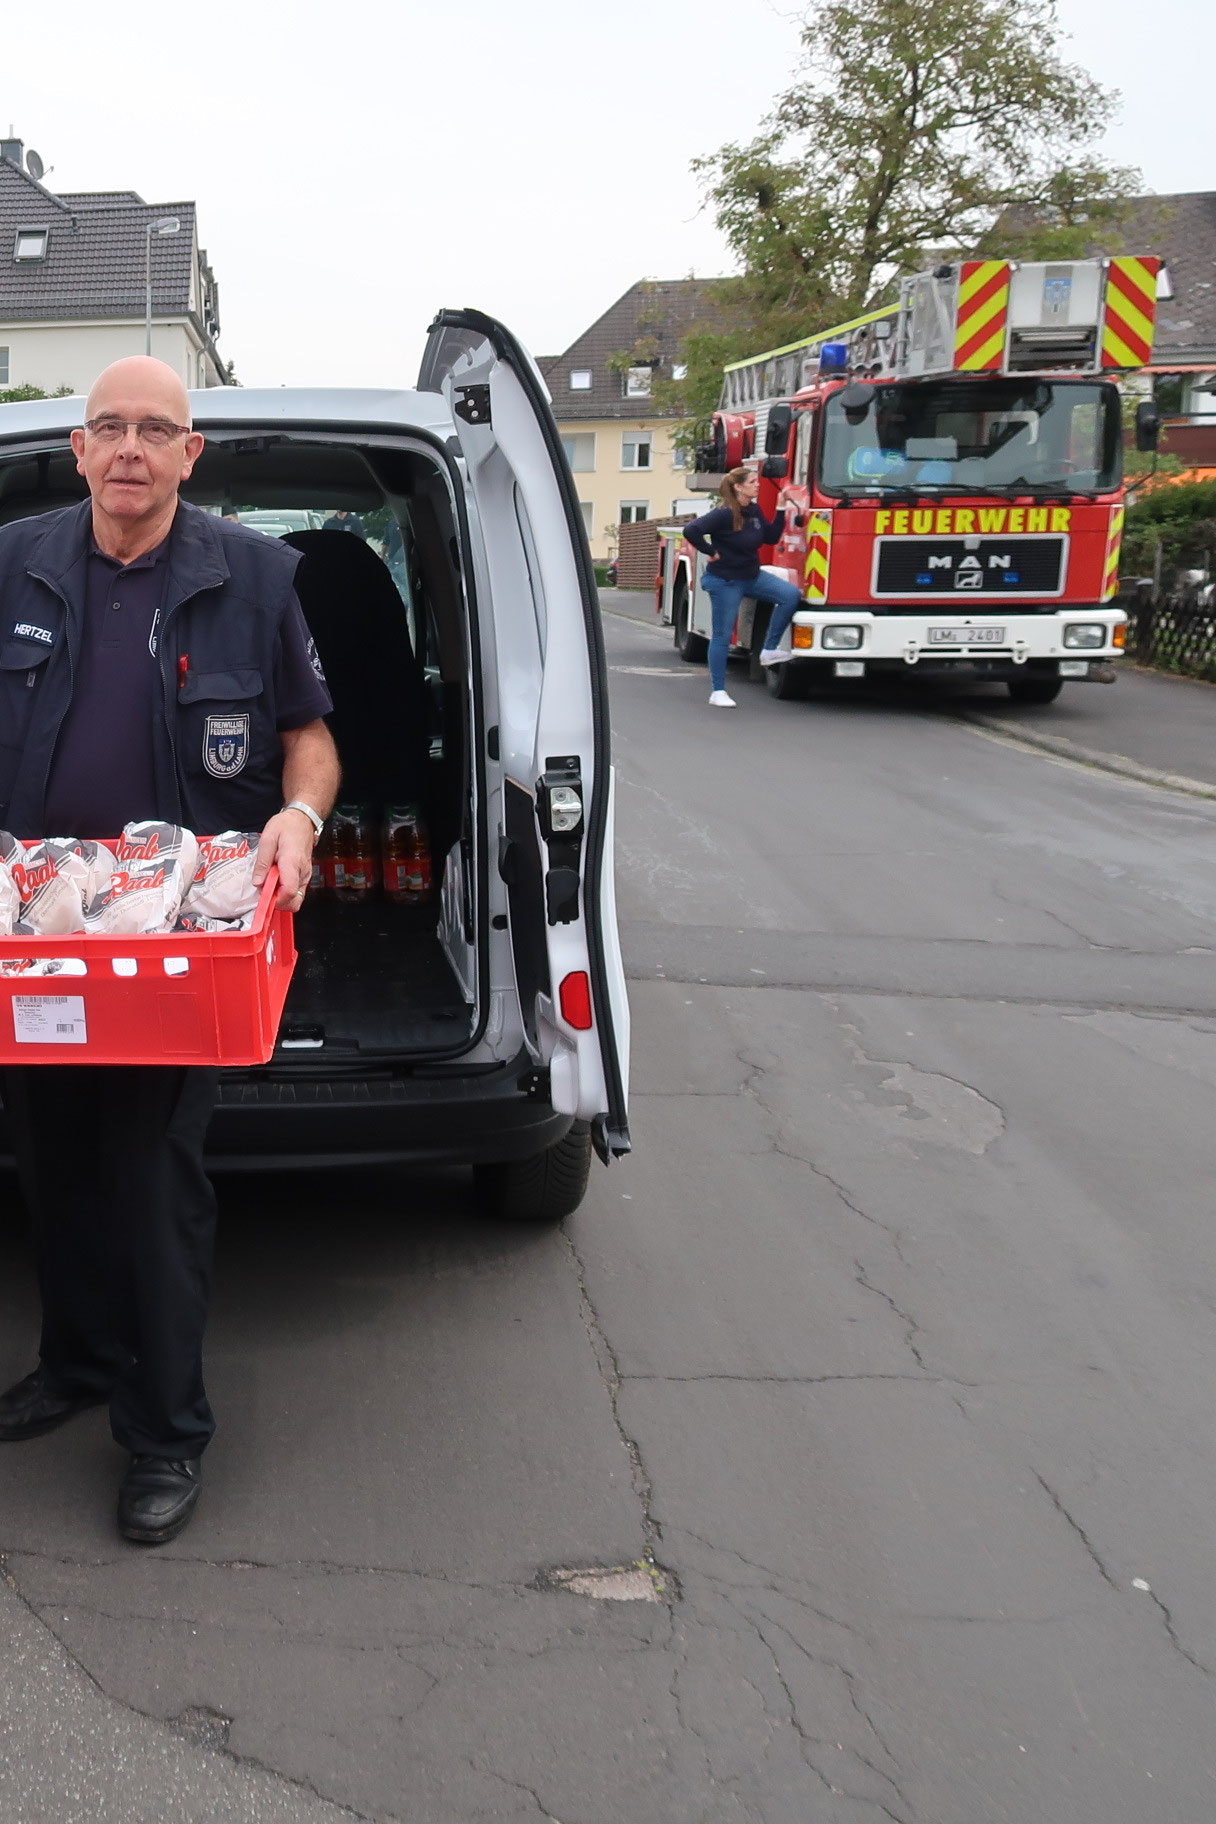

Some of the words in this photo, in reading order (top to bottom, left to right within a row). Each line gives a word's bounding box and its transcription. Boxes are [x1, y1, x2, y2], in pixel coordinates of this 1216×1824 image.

[875, 508, 1071, 534] FEUERWEHR
[928, 555, 1011, 569] MAN
[14, 623, 53, 643] HERTZEL
[210, 720, 245, 728] FREIWILLIGE
[210, 728, 245, 736] FEUERWEHR
[101, 867, 166, 905] Raab
